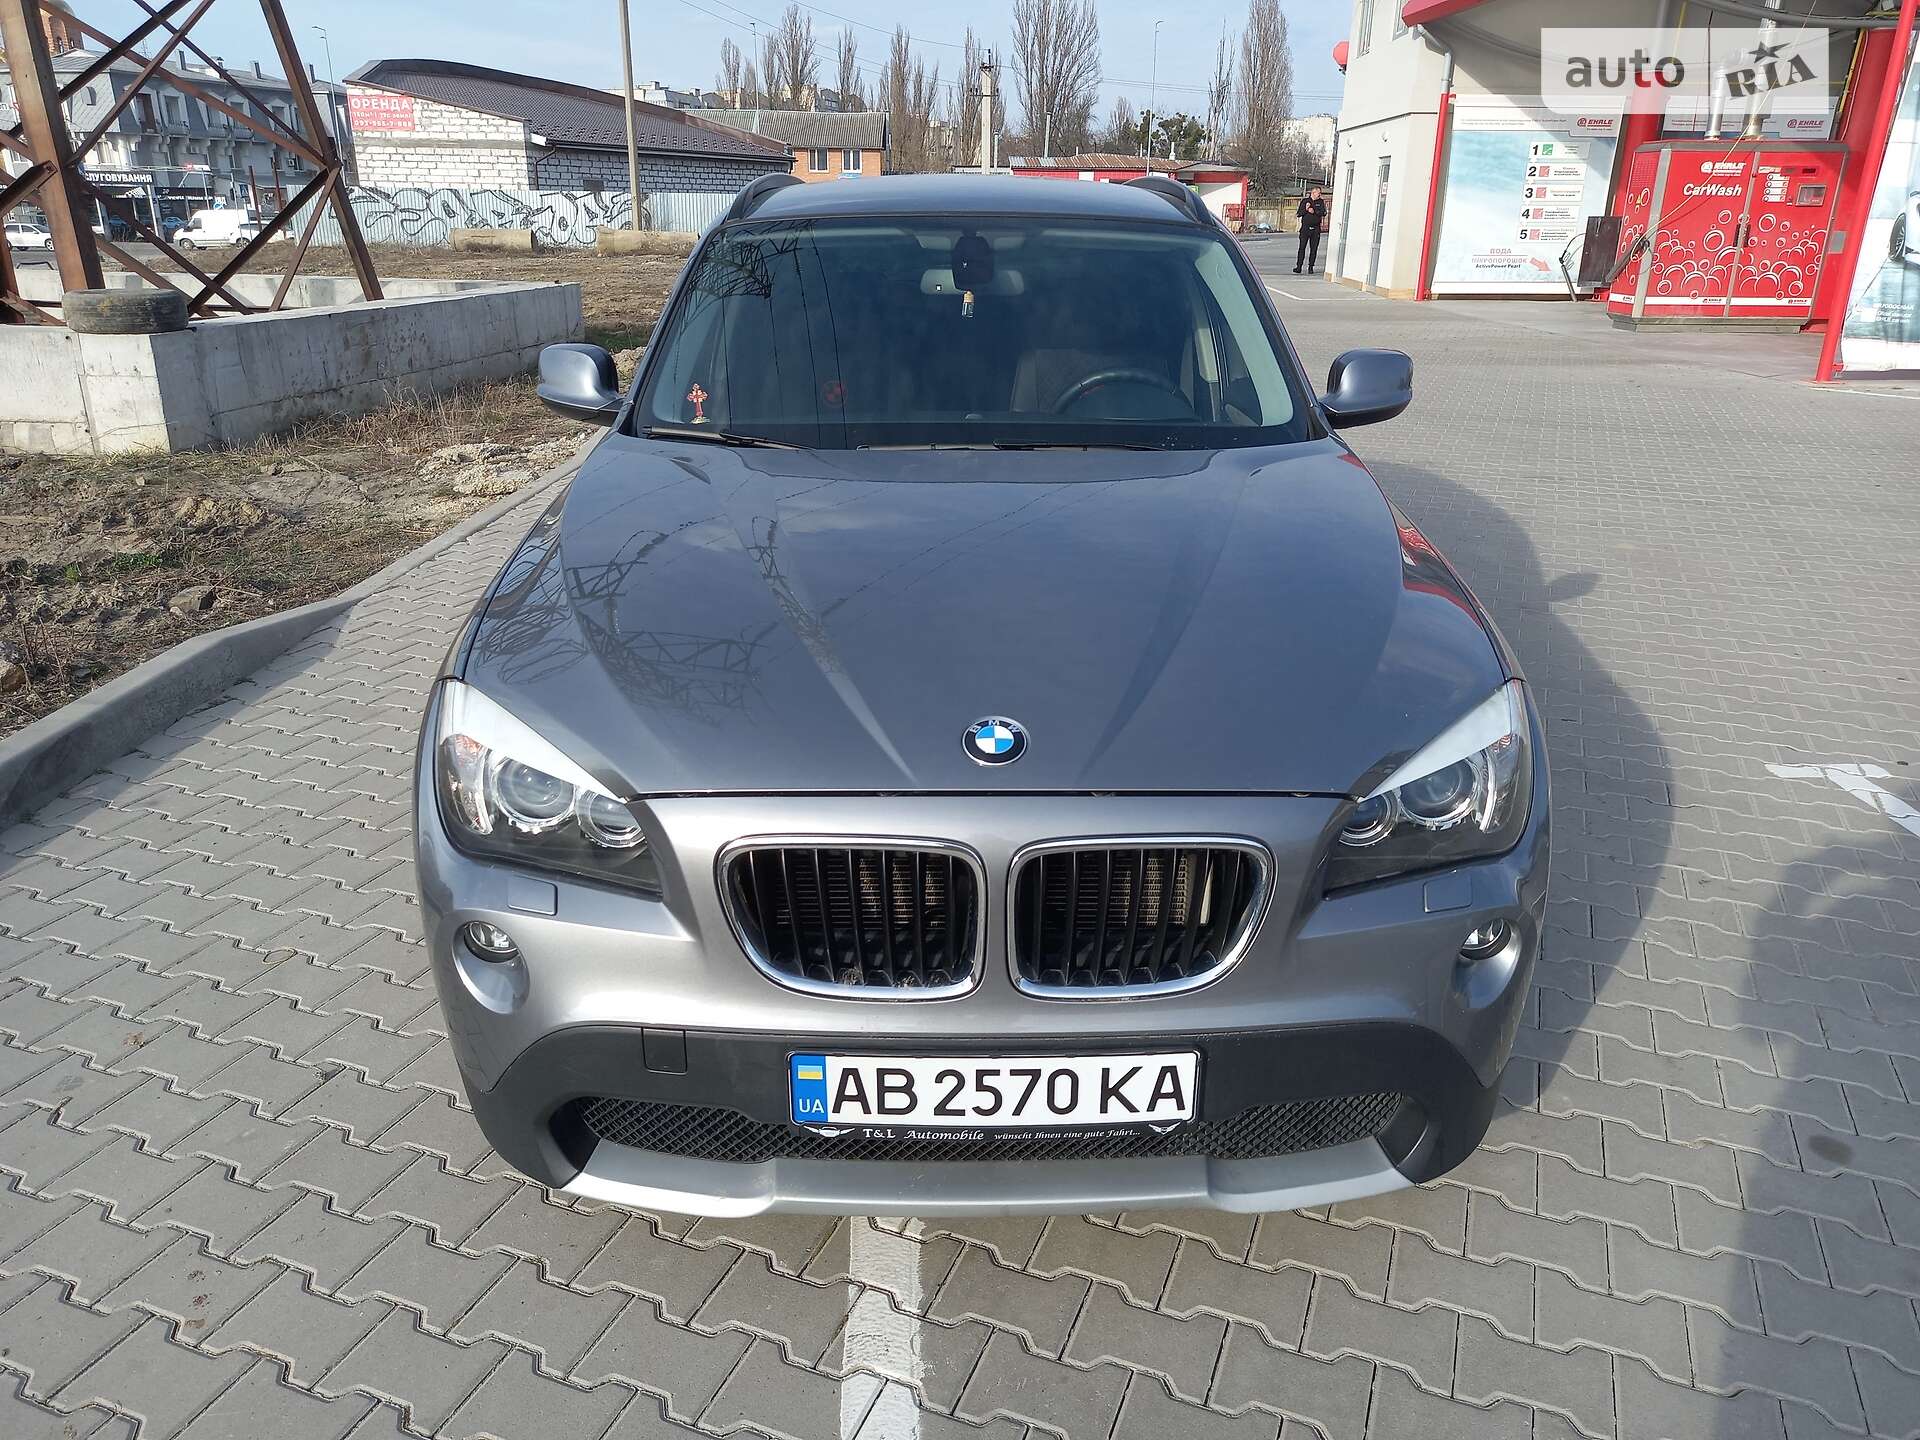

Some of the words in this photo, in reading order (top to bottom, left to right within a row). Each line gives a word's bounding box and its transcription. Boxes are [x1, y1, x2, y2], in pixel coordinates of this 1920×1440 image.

[351, 98, 411, 111] ОРЕНДА
[1532, 144, 1539, 156] 1
[1527, 166, 1537, 177] 2
[1524, 187, 1534, 199] 3
[1683, 183, 1743, 197] CarWash
[1521, 208, 1530, 219] 4
[1519, 229, 1528, 240] 5
[969, 719, 1020, 733] BMW
[832, 1067, 918, 1115] AB
[933, 1068, 1080, 1117] 2570
[1099, 1065, 1186, 1114] KA
[799, 1098, 825, 1114] UA
[903, 1130, 985, 1140] Automobile
[994, 1130, 1033, 1140] wünscht
[1034, 1130, 1061, 1140] Ihnen
[1083, 1129, 1105, 1140] gute
